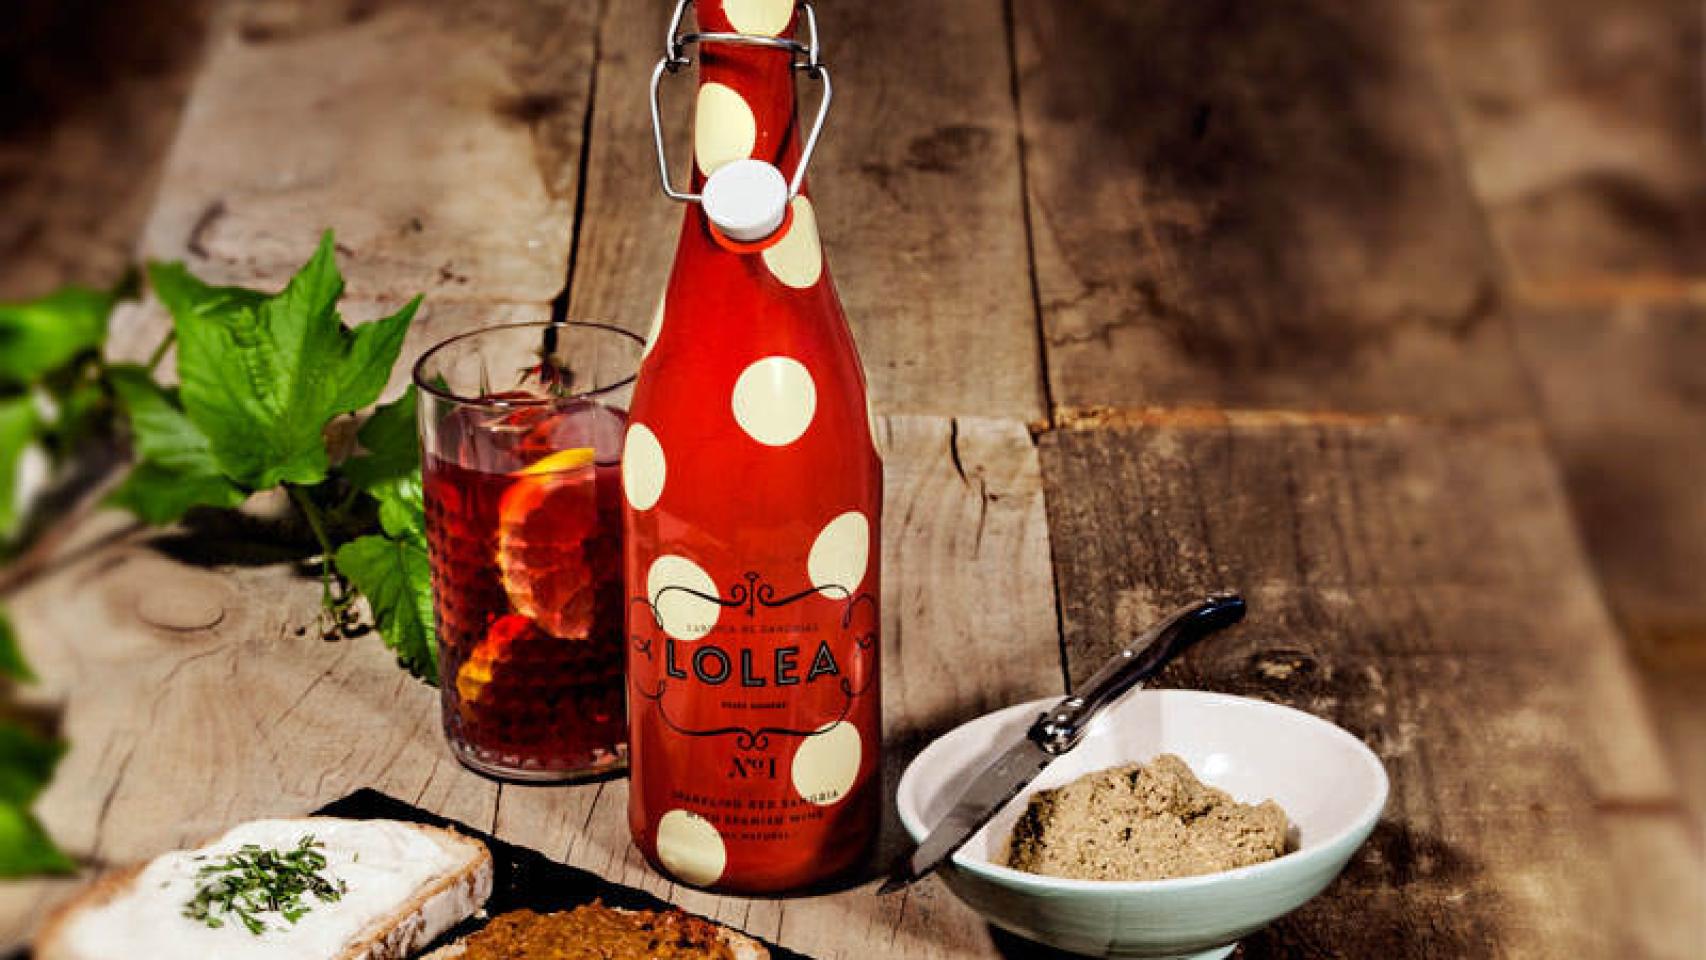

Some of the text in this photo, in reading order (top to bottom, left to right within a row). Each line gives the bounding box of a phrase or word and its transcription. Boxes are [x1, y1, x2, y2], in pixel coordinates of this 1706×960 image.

[666, 639, 840, 688] LOLEA
[748, 799, 776, 810] RED
[724, 813, 785, 826] SPANISH
